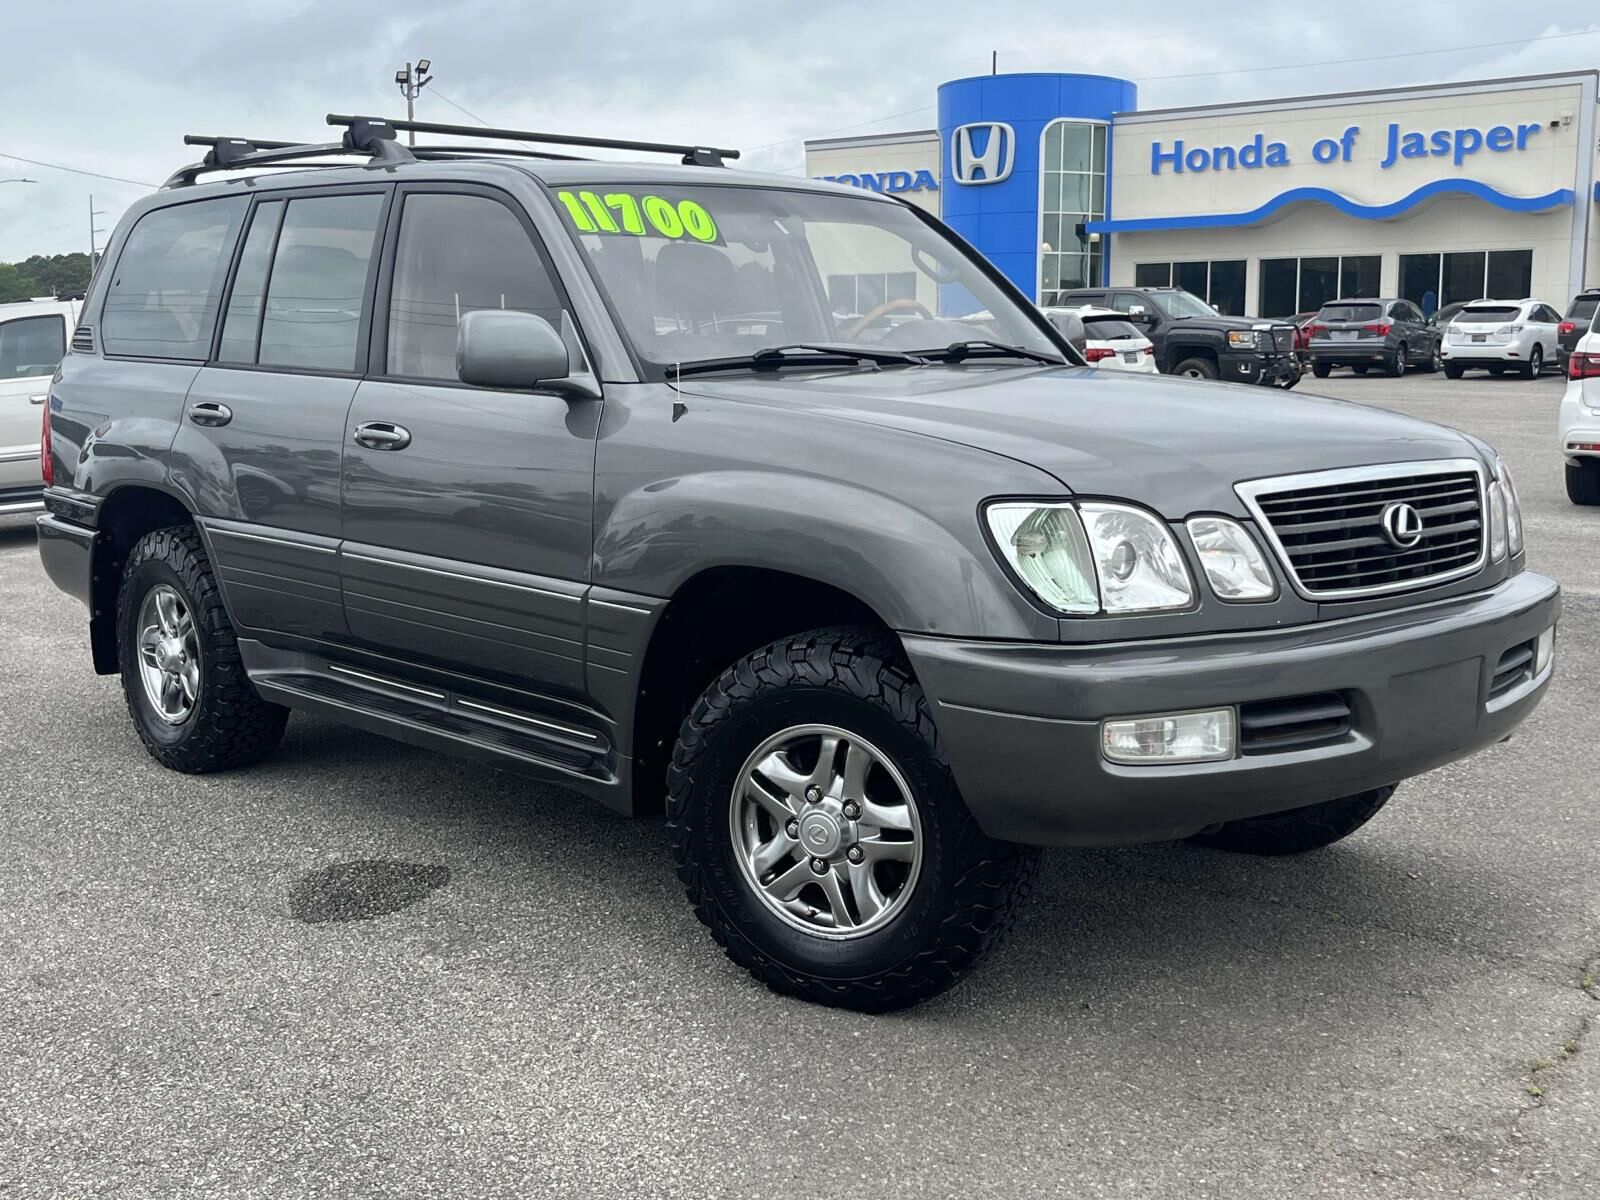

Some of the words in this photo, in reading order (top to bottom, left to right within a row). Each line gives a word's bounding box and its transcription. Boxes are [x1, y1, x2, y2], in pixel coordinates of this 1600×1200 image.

[1151, 133, 1290, 175] Honda
[1312, 126, 1360, 164] of
[1381, 123, 1541, 169] Jasper
[812, 170, 938, 193] ONDA
[558, 191, 717, 242] 11700
